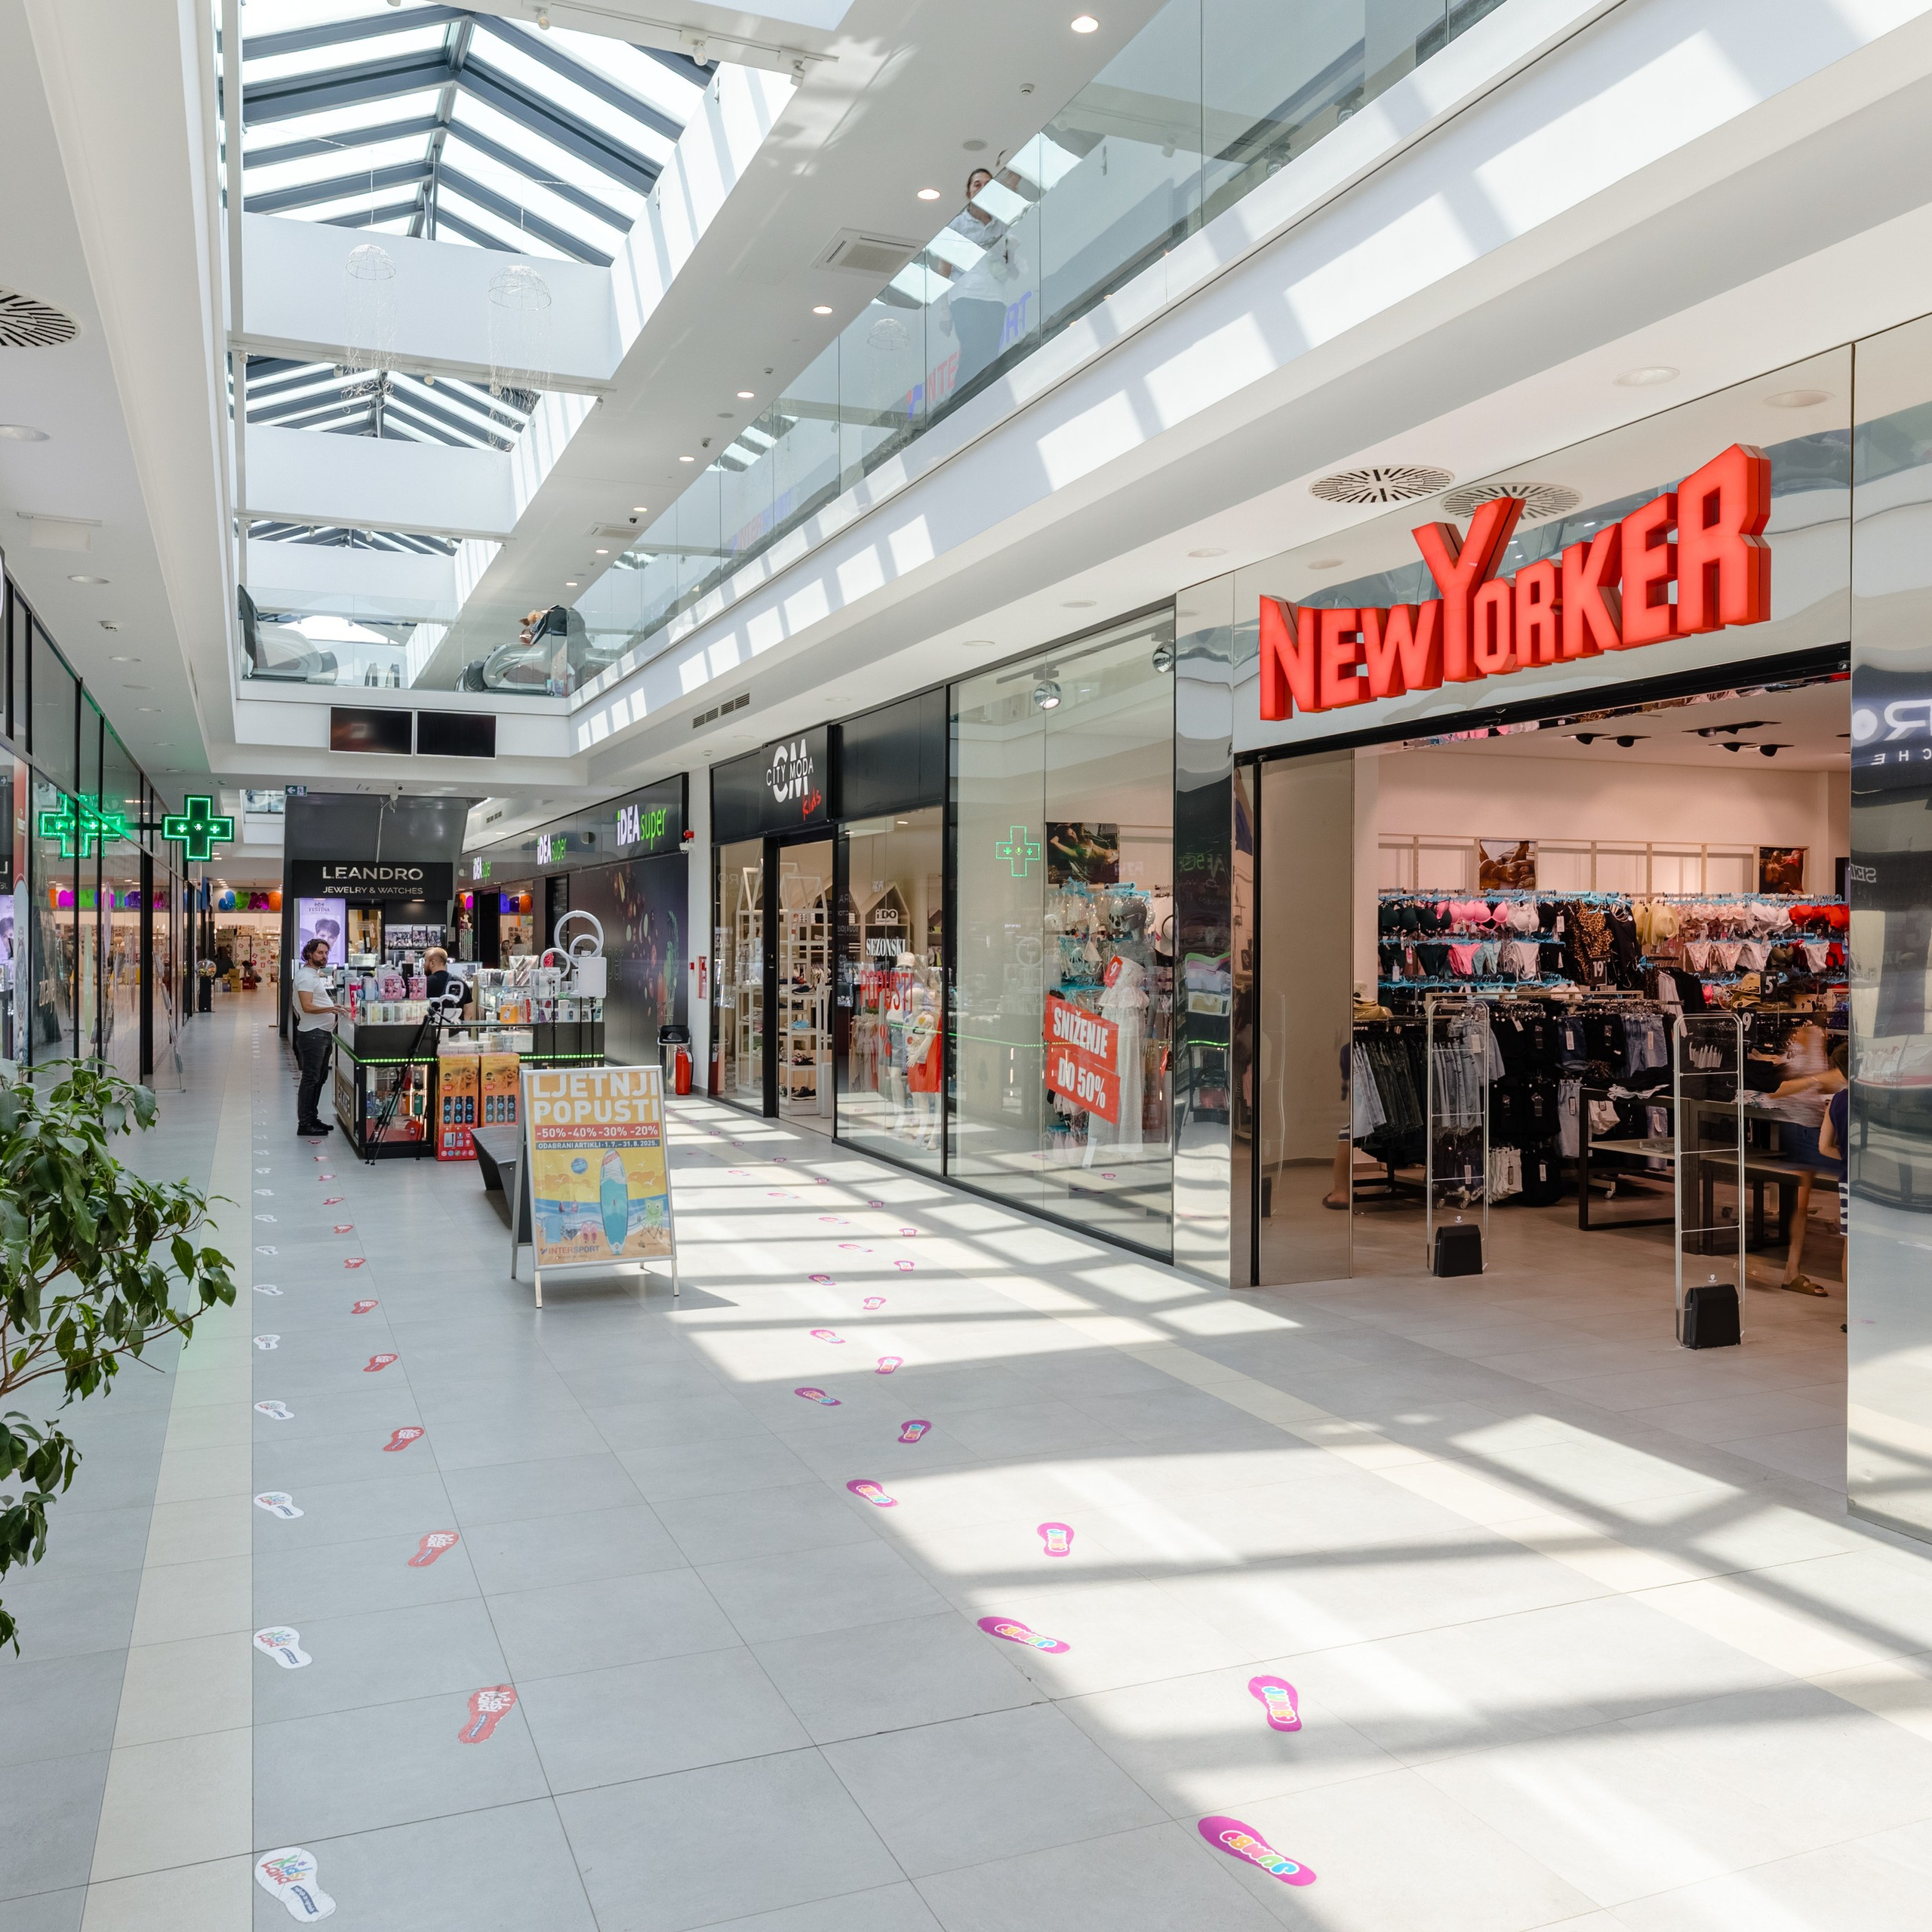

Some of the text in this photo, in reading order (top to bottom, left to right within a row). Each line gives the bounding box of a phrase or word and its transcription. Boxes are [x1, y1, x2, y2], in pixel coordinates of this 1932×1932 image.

[766, 756, 814, 786] CITY MODA
[322, 866, 423, 881] LEANDRO
[218, 890, 282, 911] JUMB
[322, 886, 368, 894] JEWELRY
[866, 938, 906, 956] SEZONSKI
[860, 969, 914, 1011] POPUSTI
[1054, 1007, 1109, 1059] SNIŽENJE
[533, 1072, 658, 1098] LJETNJI
[1058, 1057, 1106, 1109] DO 50%
[534, 1099, 660, 1124] POPUSTI
[537, 1125, 658, 1138] -50% -40% -30% -20%
[549, 1245, 600, 1254] INTERSPORT
